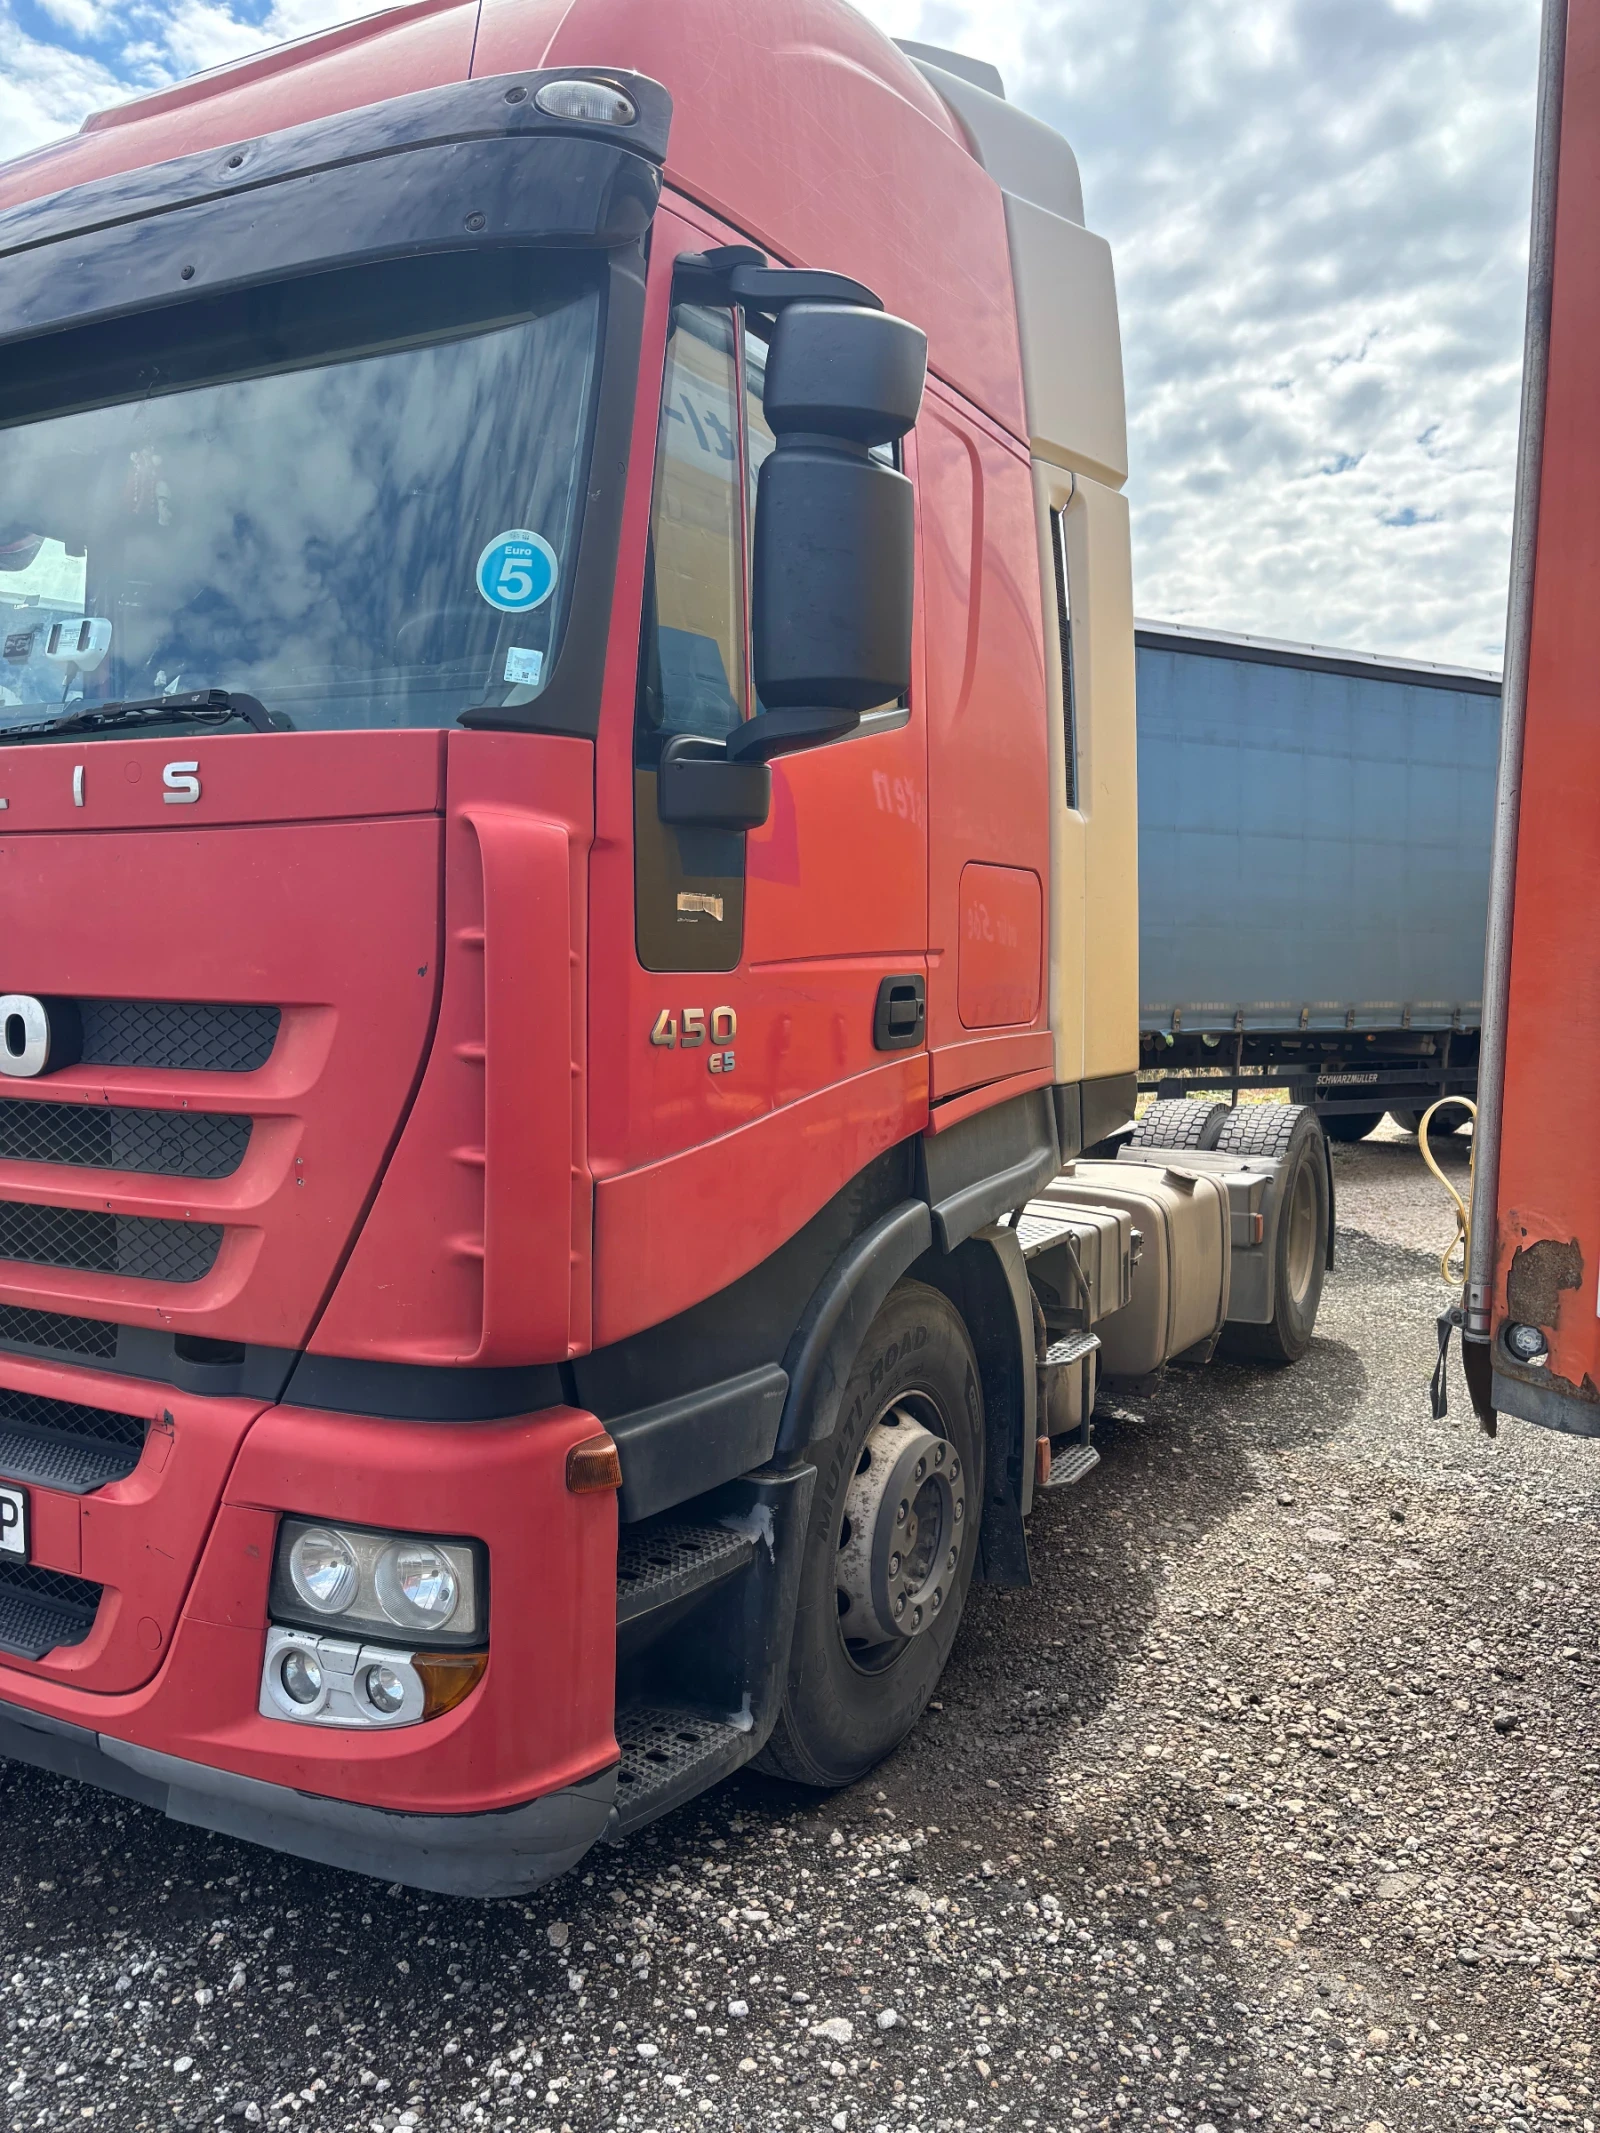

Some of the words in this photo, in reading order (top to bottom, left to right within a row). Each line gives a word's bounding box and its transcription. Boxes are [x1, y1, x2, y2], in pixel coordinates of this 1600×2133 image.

[504, 546, 532, 556] Euro
[497, 557, 533, 600] 5
[650, 1005, 737, 1049] 450
[708, 1051, 736, 1074] E5
[816, 1325, 928, 1542] MULTI-ROAD
